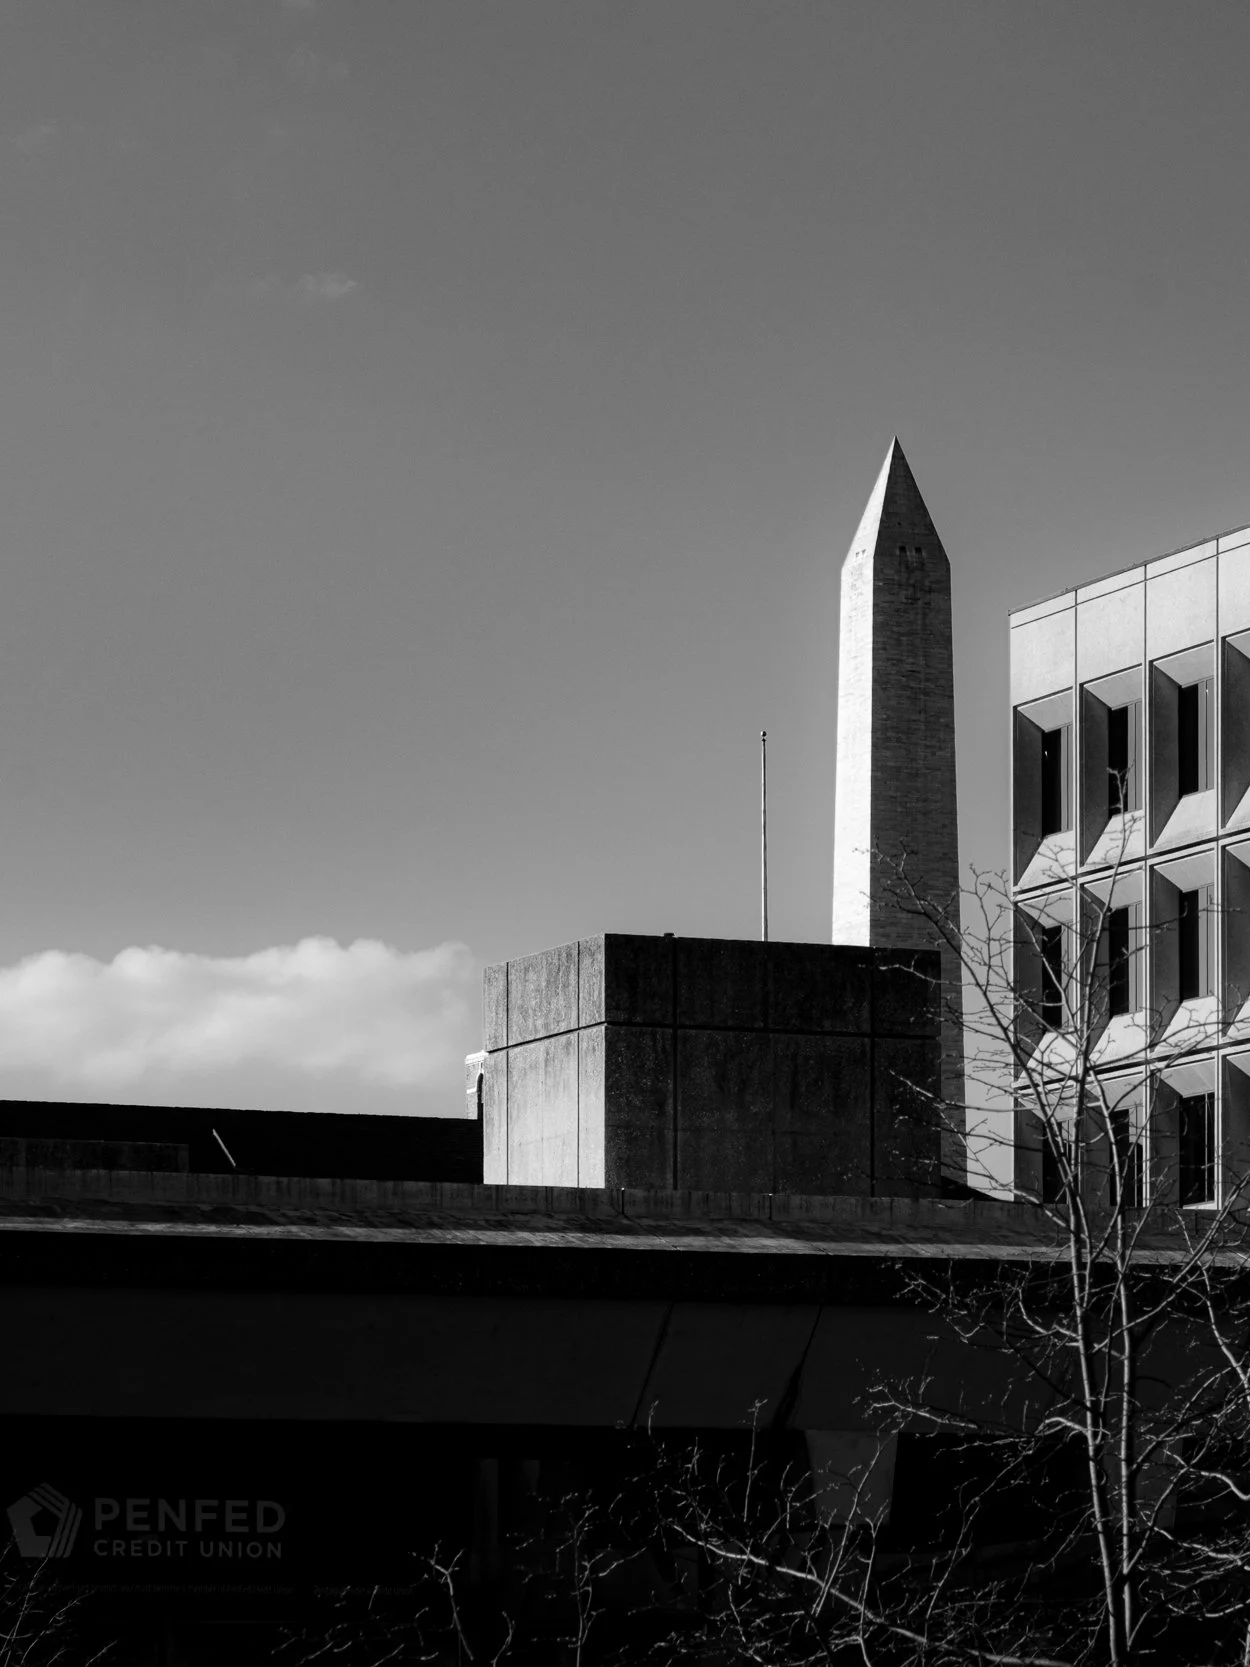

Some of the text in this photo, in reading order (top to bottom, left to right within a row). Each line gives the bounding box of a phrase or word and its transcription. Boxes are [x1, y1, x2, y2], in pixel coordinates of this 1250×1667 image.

[94, 1497, 286, 1533] PENFED
[94, 1540, 282, 1558] CREDIT UNION
